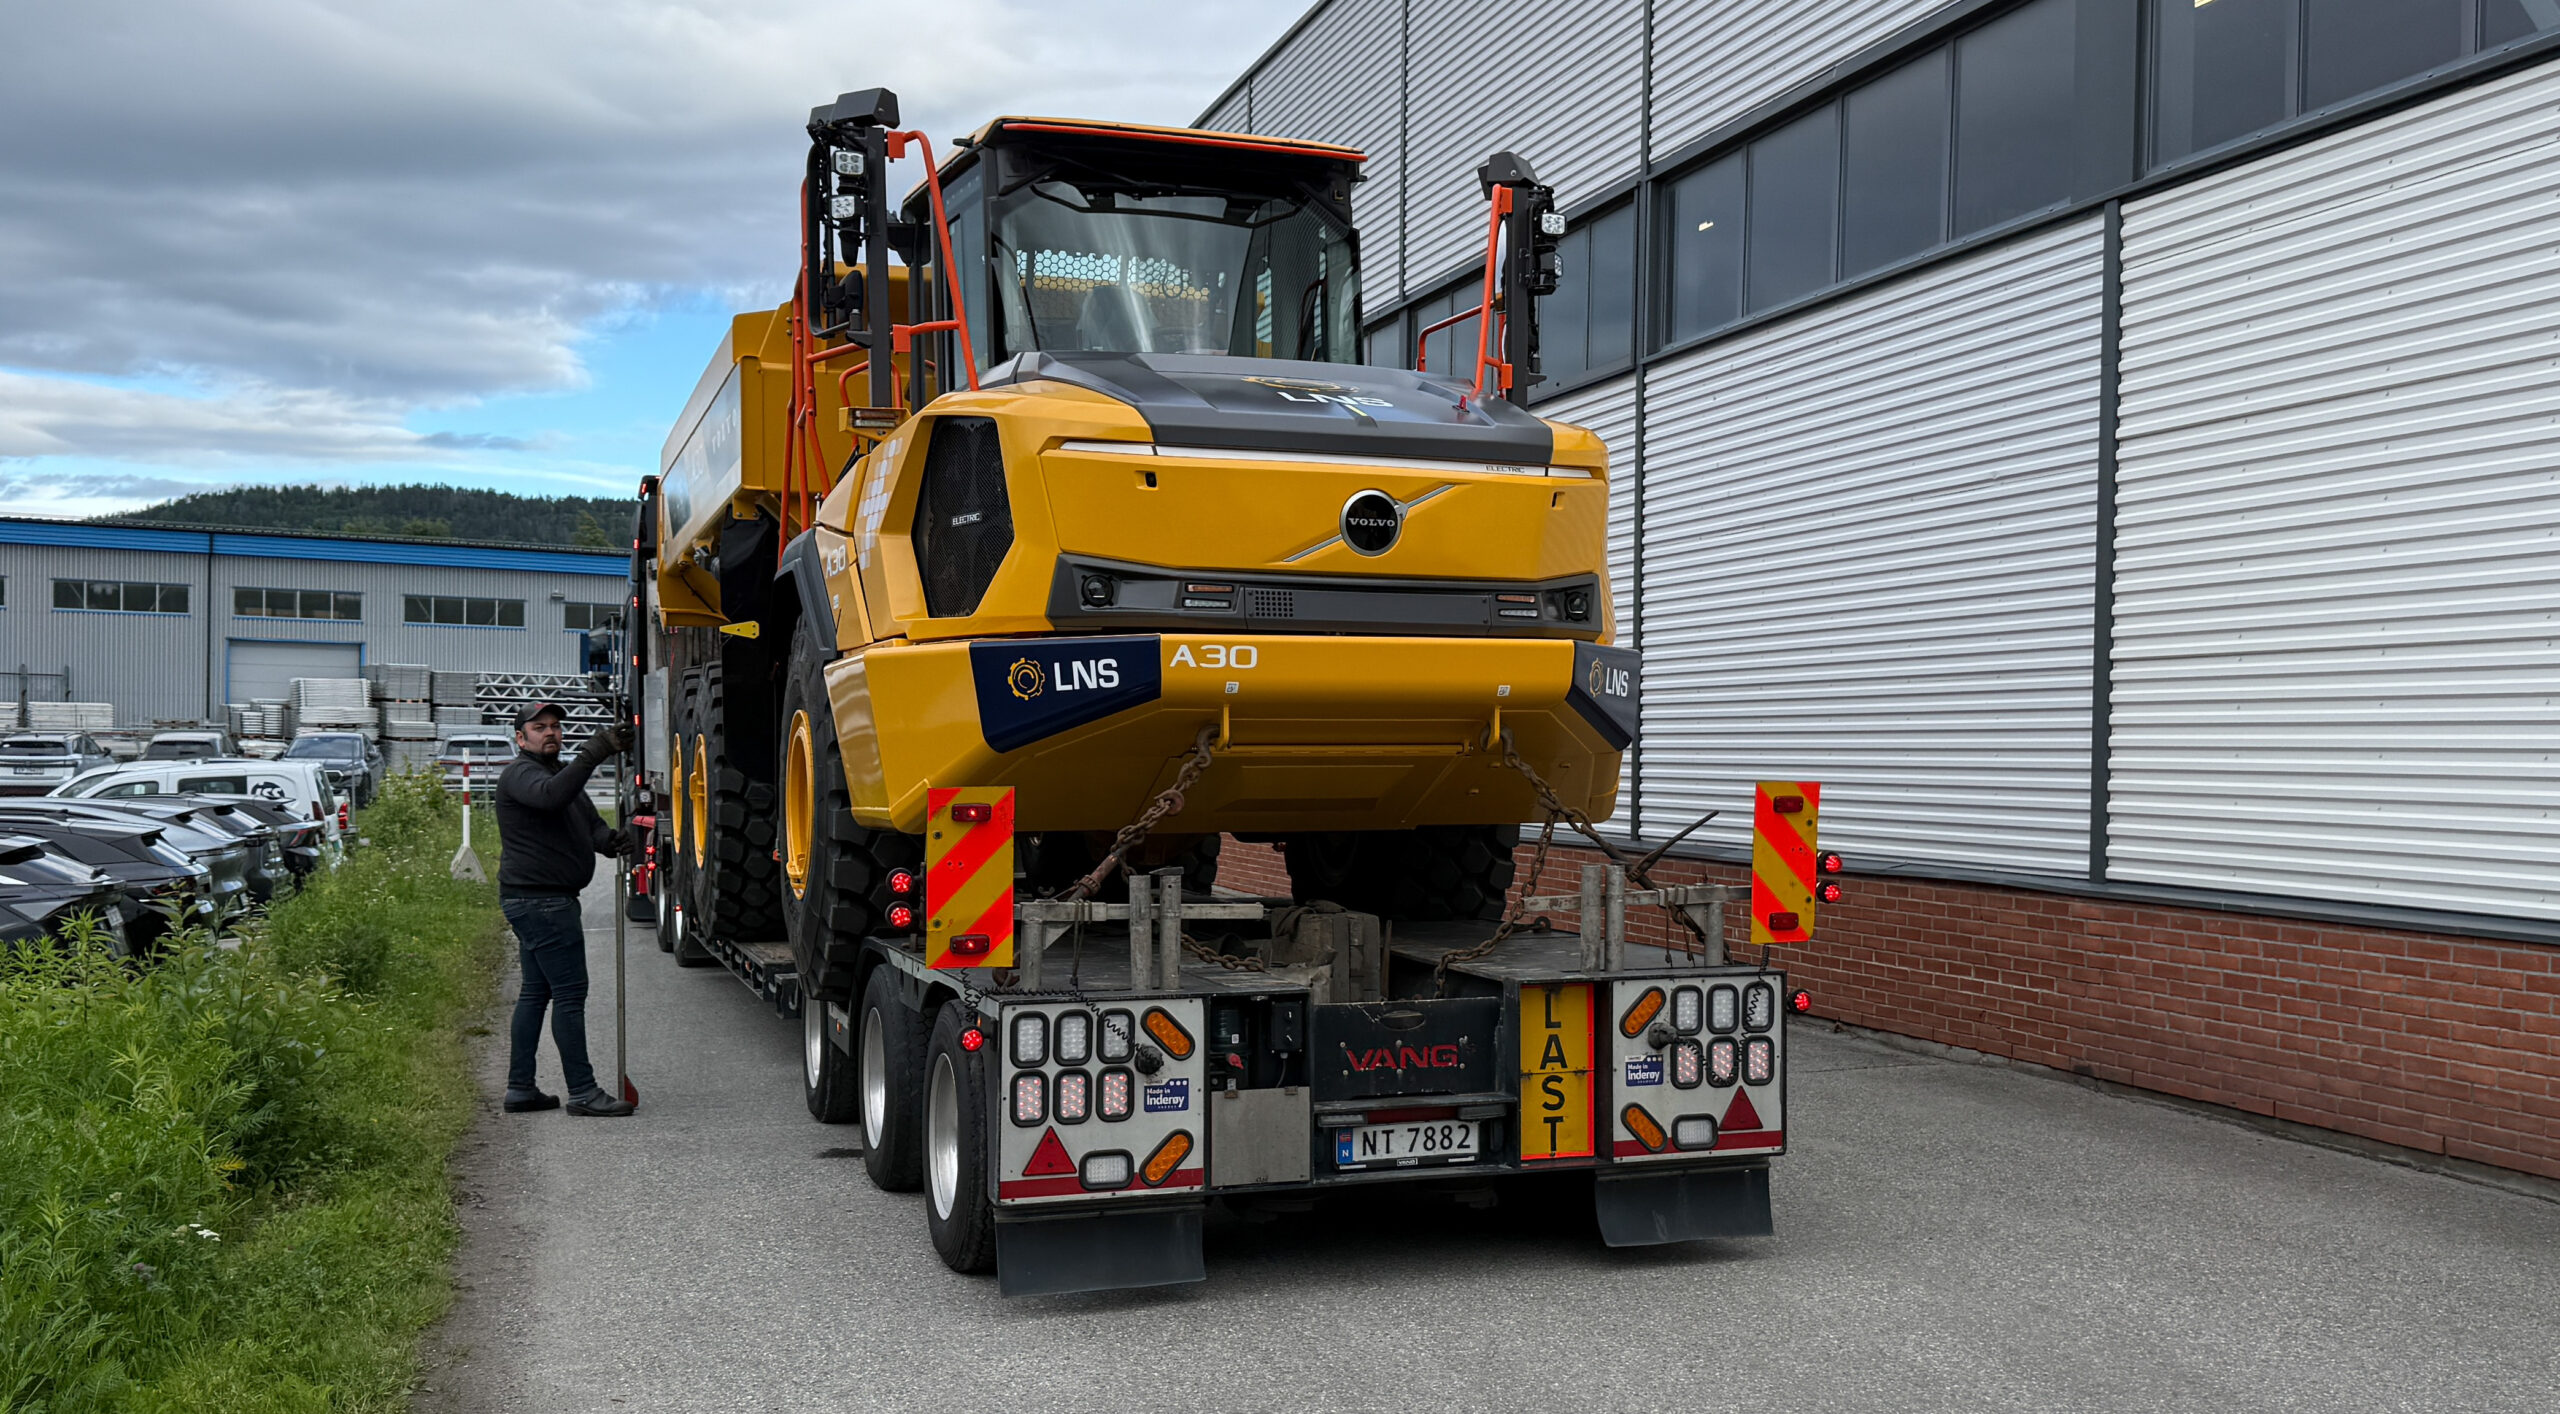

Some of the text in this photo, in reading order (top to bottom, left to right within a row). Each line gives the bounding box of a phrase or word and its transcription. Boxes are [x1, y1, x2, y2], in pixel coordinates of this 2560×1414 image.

[1277, 391, 1394, 408] LNS
[1485, 465, 1525, 474] ELECTRIC
[952, 512, 981, 526] ELECTRIC
[1348, 518, 1396, 528] VOLVO
[825, 544, 846, 579] A30
[1169, 644, 1258, 669] A30
[1053, 658, 1120, 692] LNS
[1605, 667, 1629, 698] LNS
[1345, 1044, 1460, 1072] VANG
[1539, 991, 1569, 1153] LAST
[1146, 1095, 1185, 1108] Inderøy
[1361, 1124, 1471, 1156] NT 7882
[1341, 1149, 1349, 1158] N
